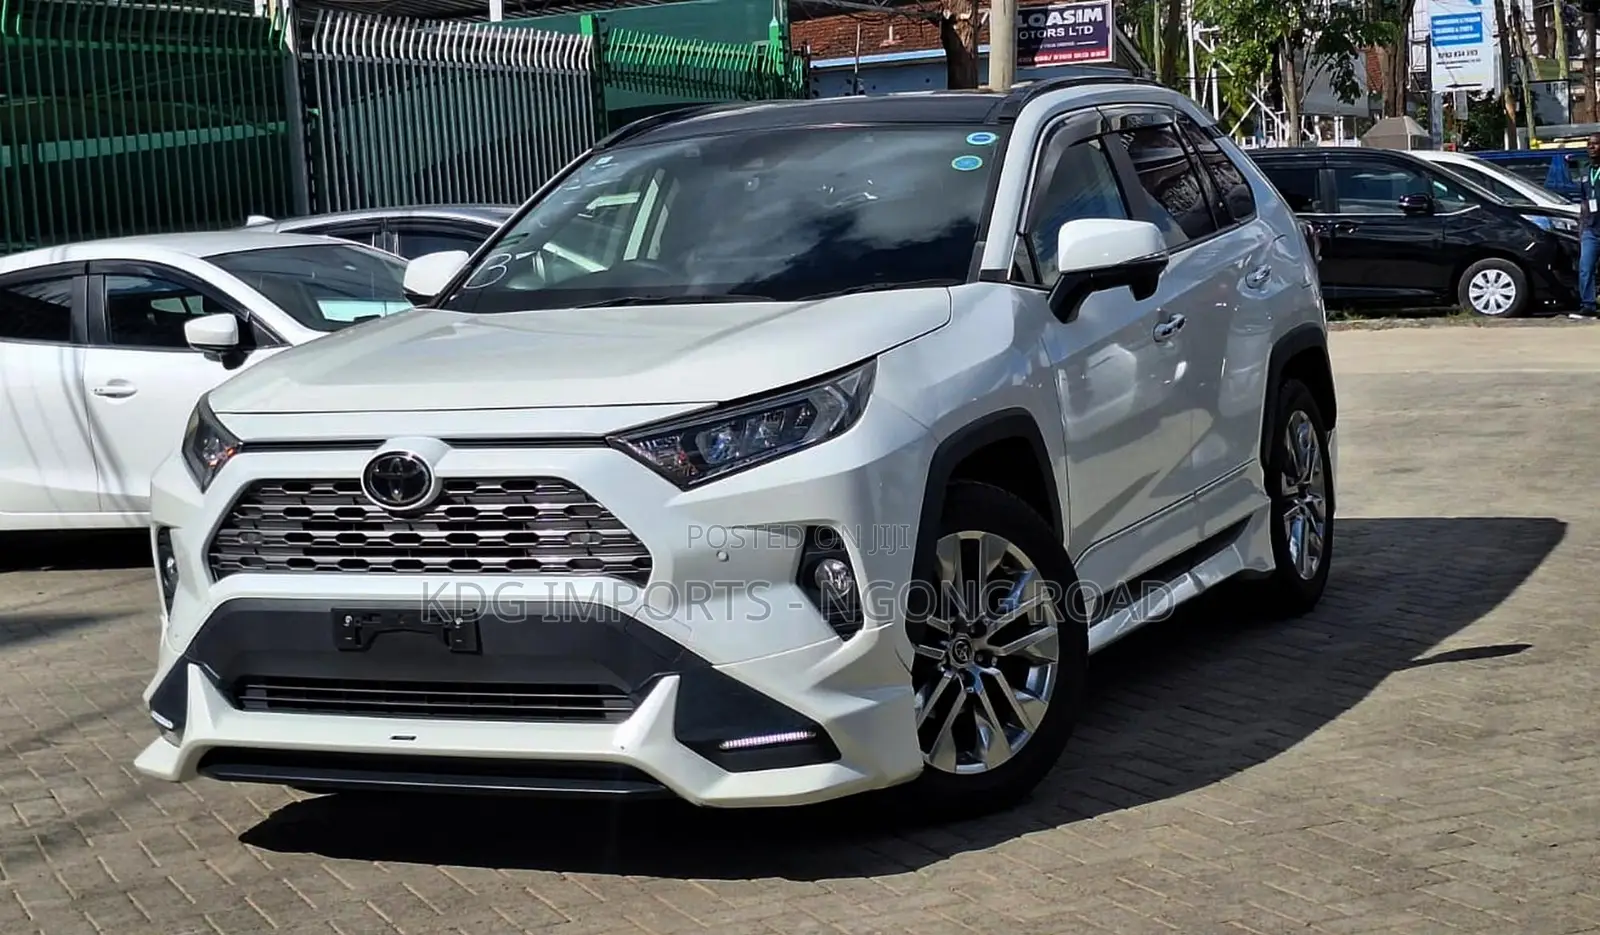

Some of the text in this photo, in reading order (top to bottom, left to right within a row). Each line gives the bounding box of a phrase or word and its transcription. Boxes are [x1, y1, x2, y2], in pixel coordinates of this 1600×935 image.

[1016, 8, 1103, 27] LQASIM
[1019, 25, 1094, 40] OTORS LTD
